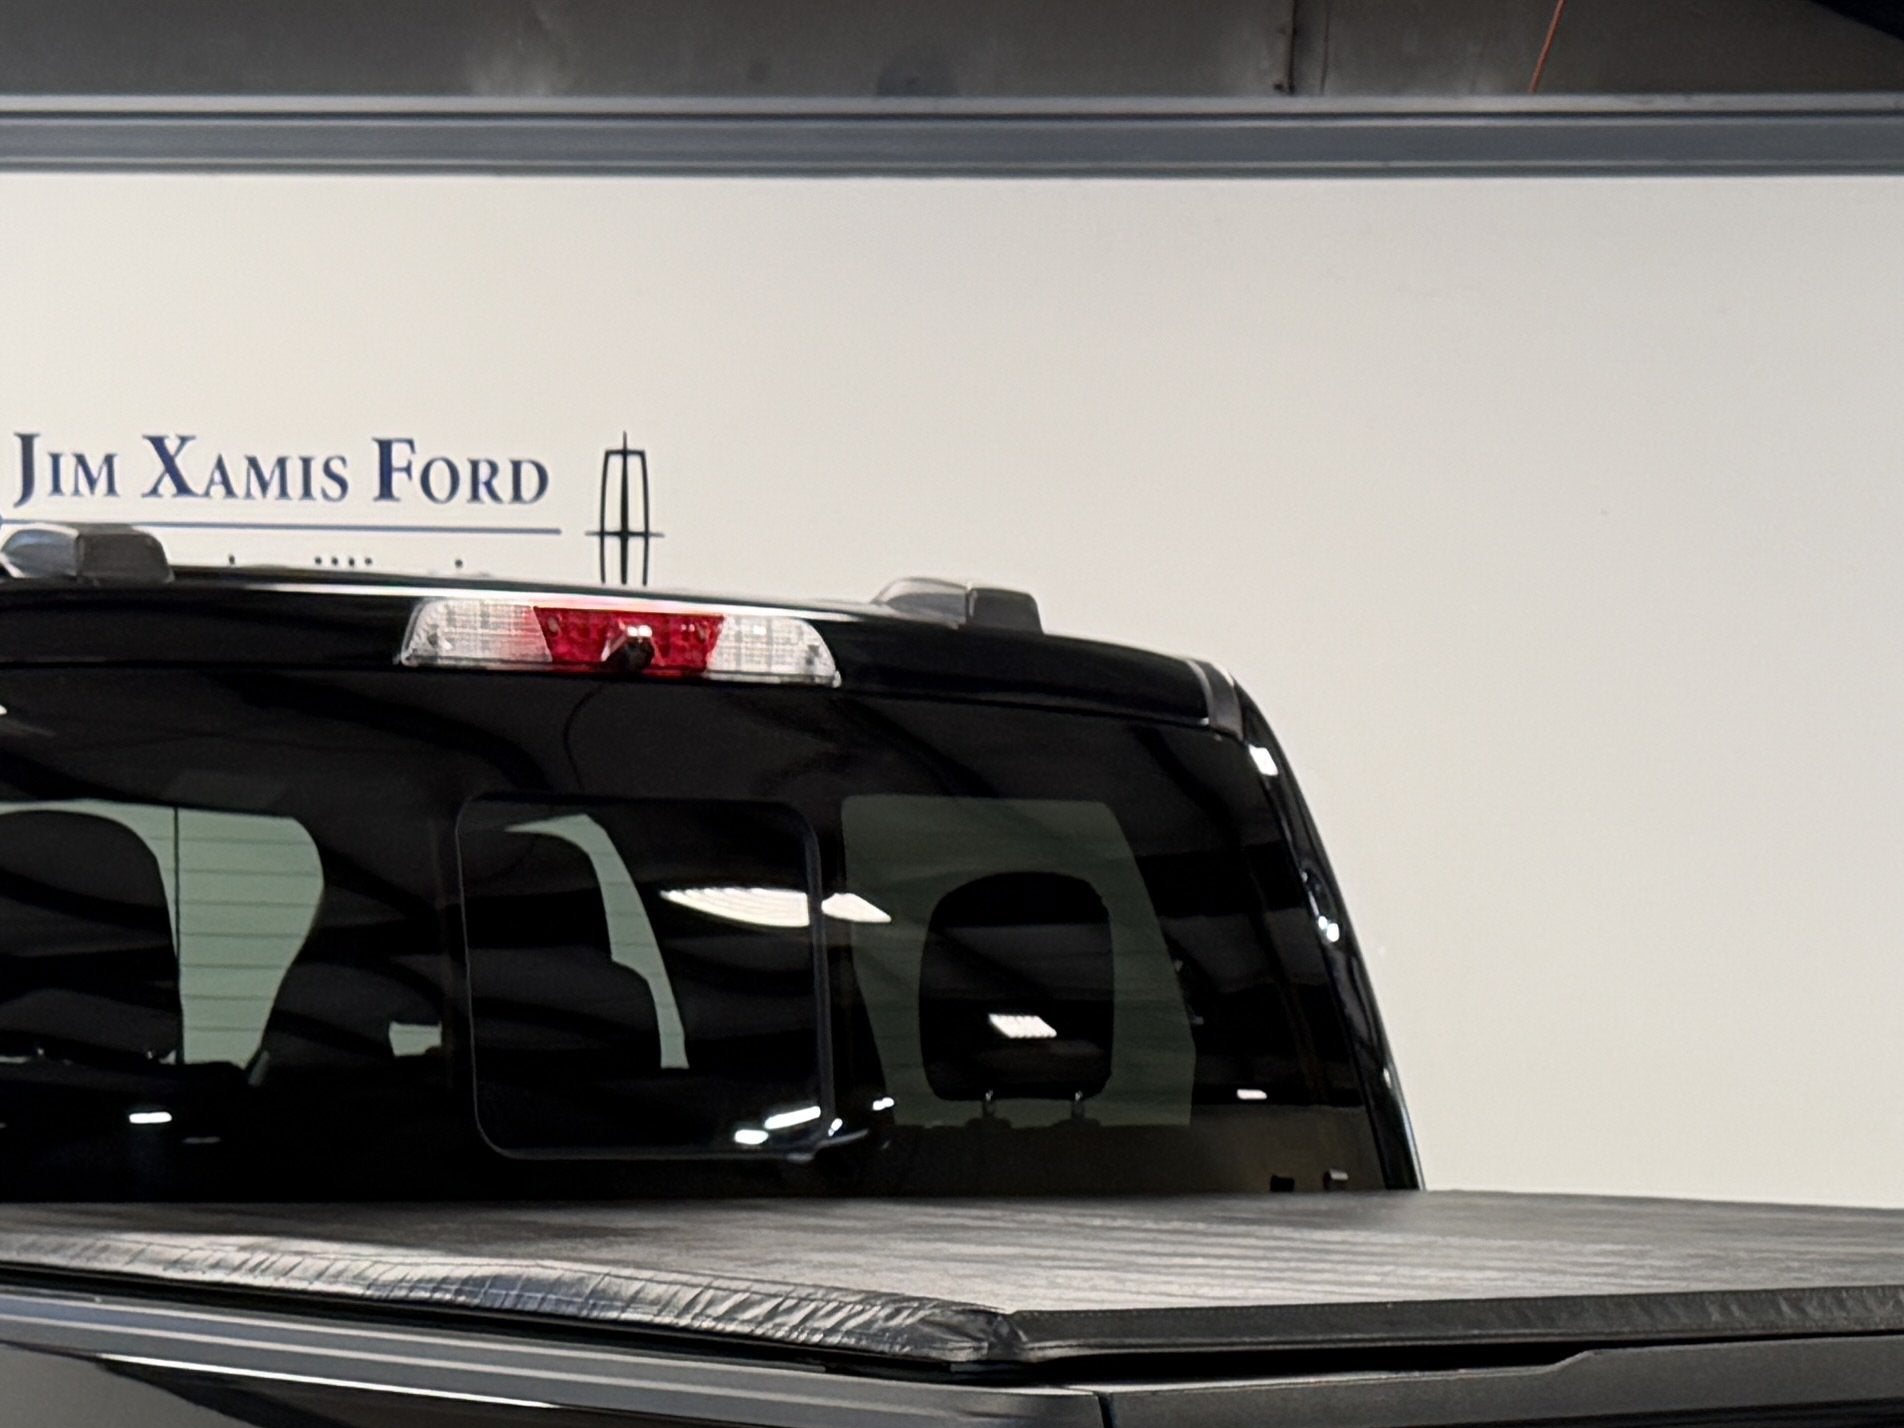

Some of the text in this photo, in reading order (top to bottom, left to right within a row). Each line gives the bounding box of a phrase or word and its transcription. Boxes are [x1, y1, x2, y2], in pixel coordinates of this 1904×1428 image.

[13, 431, 551, 509] JIM XAMIS FORD
